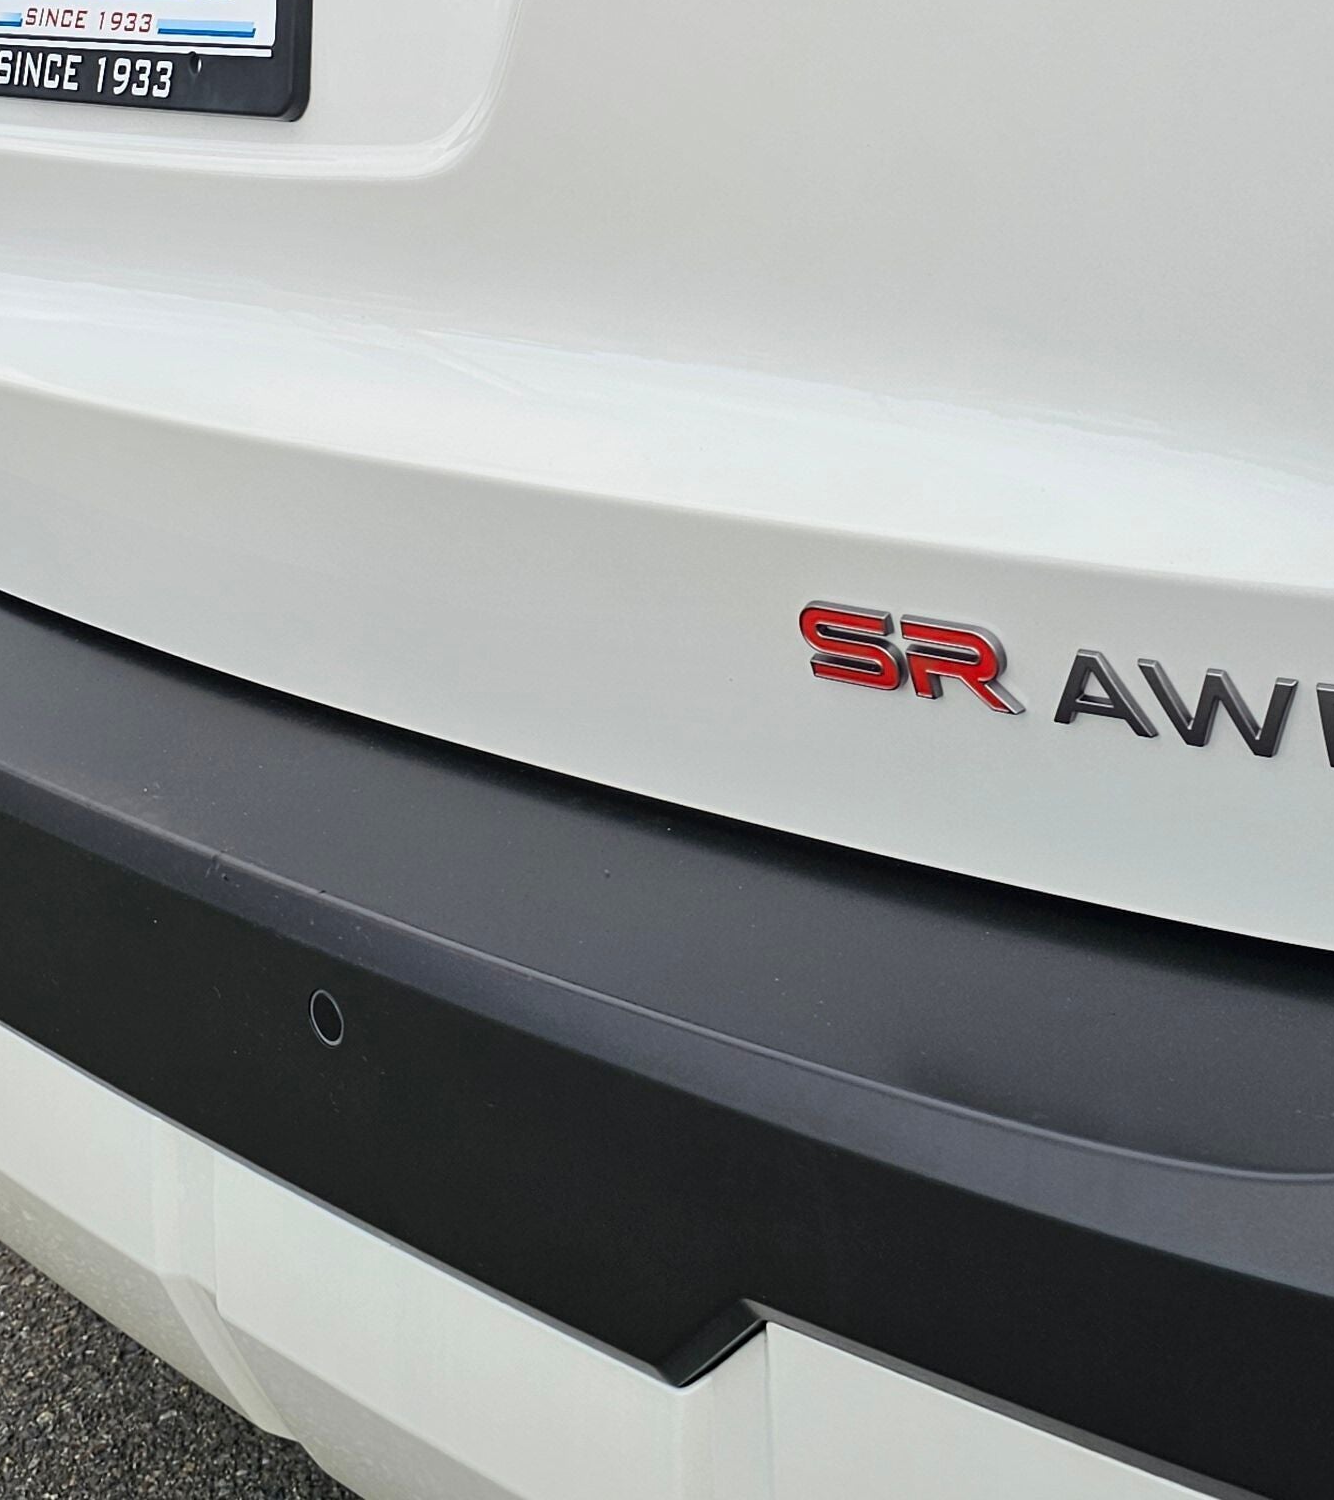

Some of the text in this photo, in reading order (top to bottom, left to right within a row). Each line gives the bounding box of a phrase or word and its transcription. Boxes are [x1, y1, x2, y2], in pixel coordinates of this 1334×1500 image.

[24, 7, 154, 33] SINCE 1933
[95, 55, 174, 99] 1933
[798, 600, 1026, 715] SR
